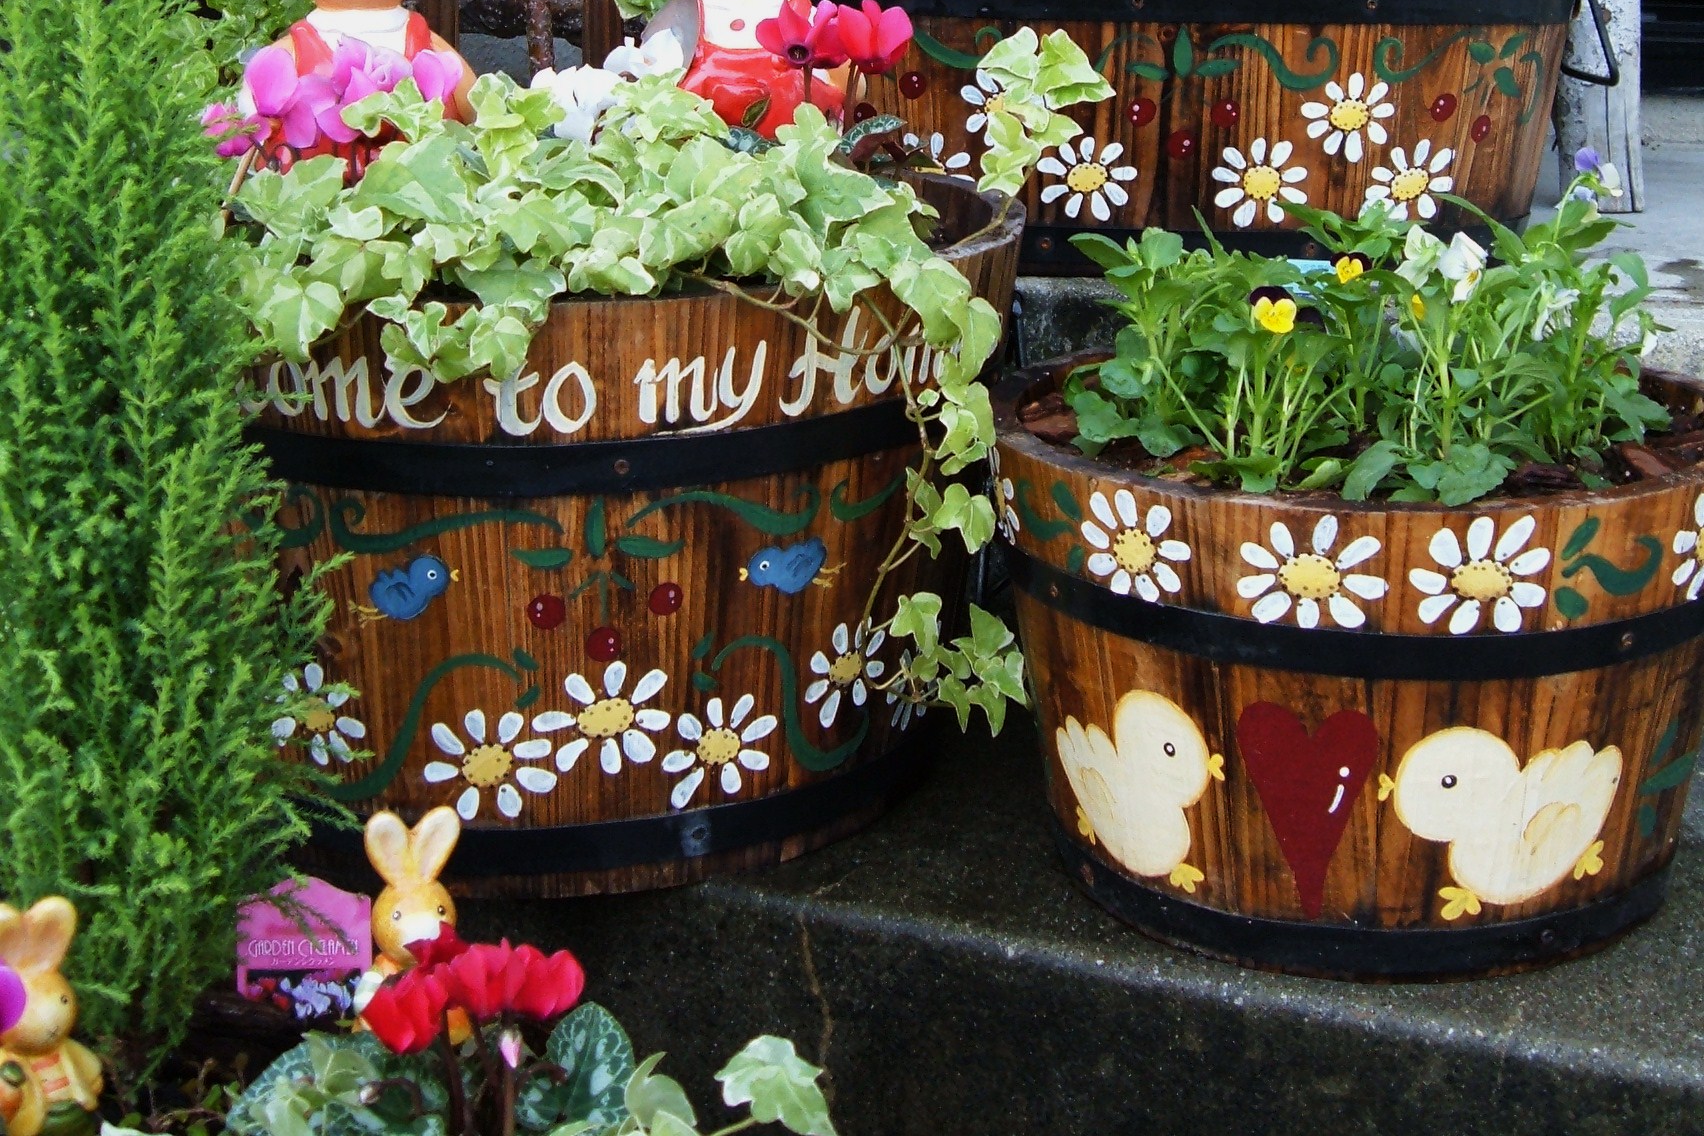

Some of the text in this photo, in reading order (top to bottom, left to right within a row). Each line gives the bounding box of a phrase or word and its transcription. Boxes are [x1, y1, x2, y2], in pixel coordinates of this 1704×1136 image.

[482, 360, 597, 437] to
[633, 339, 767, 437] my
[779, 305, 962, 417] Hom
[248, 939, 295, 957] GARDEN
